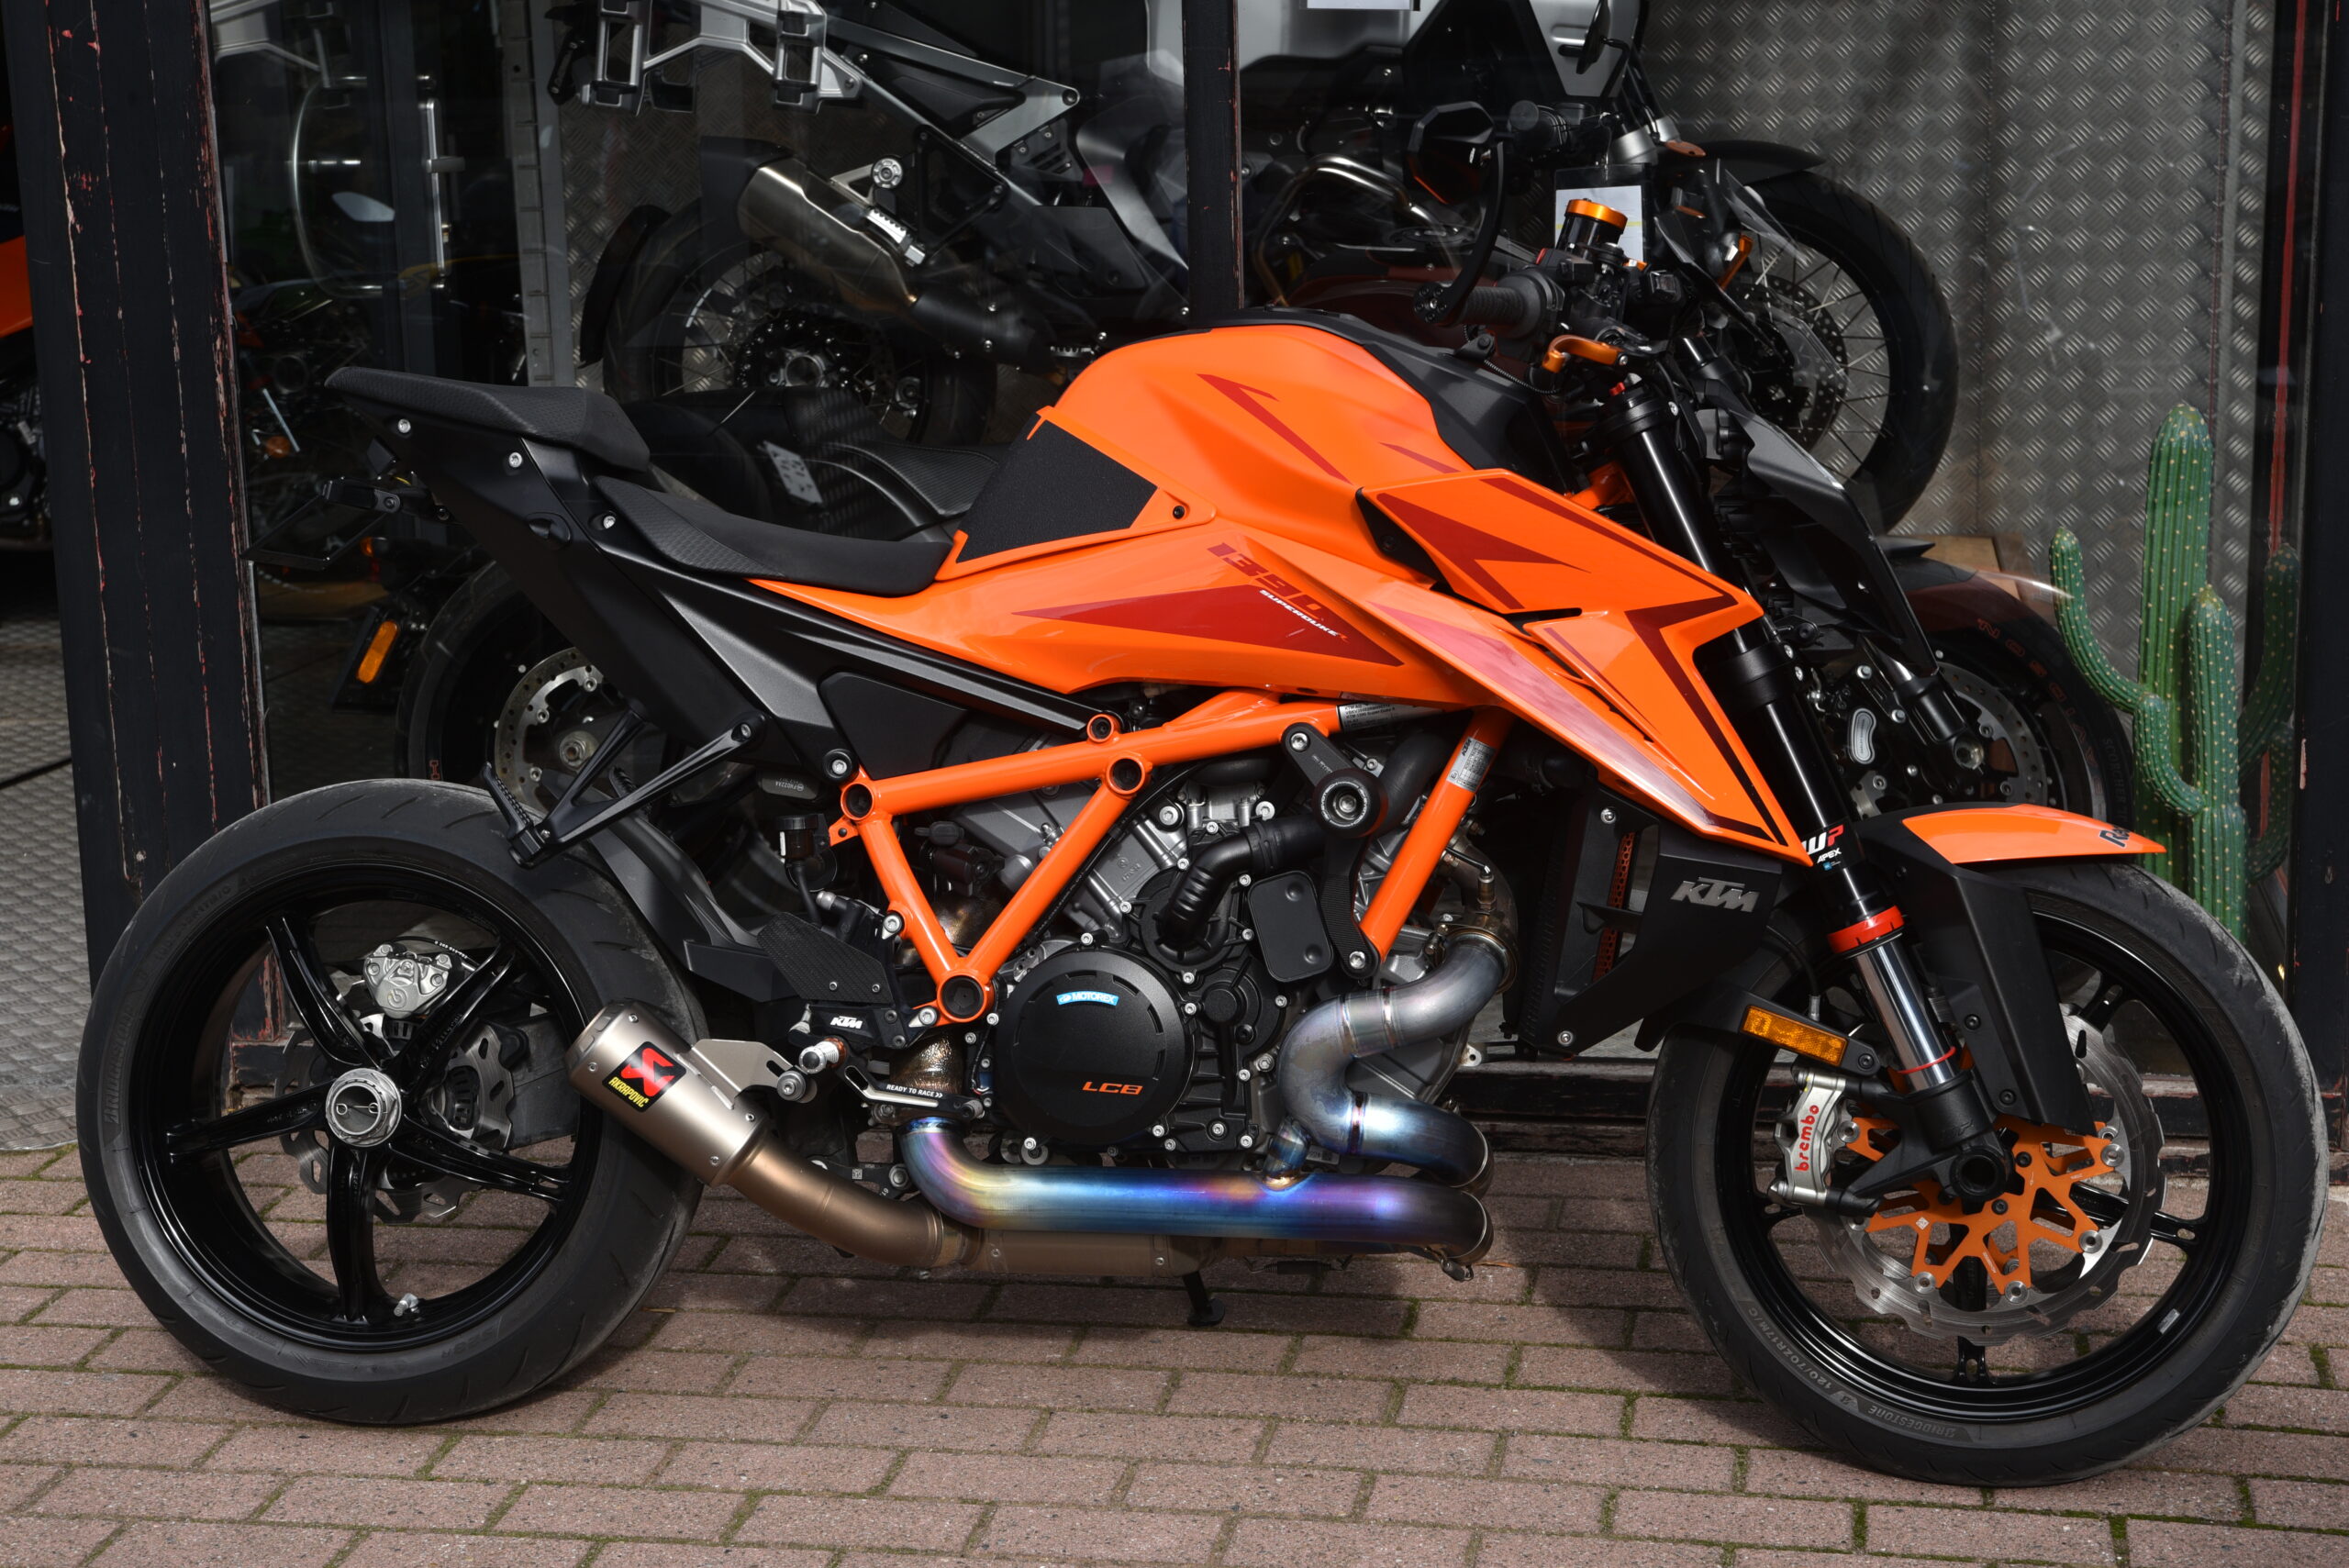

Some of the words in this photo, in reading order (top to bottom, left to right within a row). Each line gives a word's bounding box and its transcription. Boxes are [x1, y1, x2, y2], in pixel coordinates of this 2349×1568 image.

[1207, 542, 1324, 619] 1390
[1259, 589, 1338, 637] SUPERDUKE
[1817, 847, 1842, 863] APEX
[1670, 876, 1760, 913] KTM
[1072, 992, 1116, 1004] MOTOREX
[829, 1016, 863, 1029] KTM
[886, 1084, 907, 1093] READY
[918, 1090, 934, 1098] RACE
[1795, 1105, 1819, 1172] brembo
[1867, 1404, 1956, 1439] BRIDGESTONE
